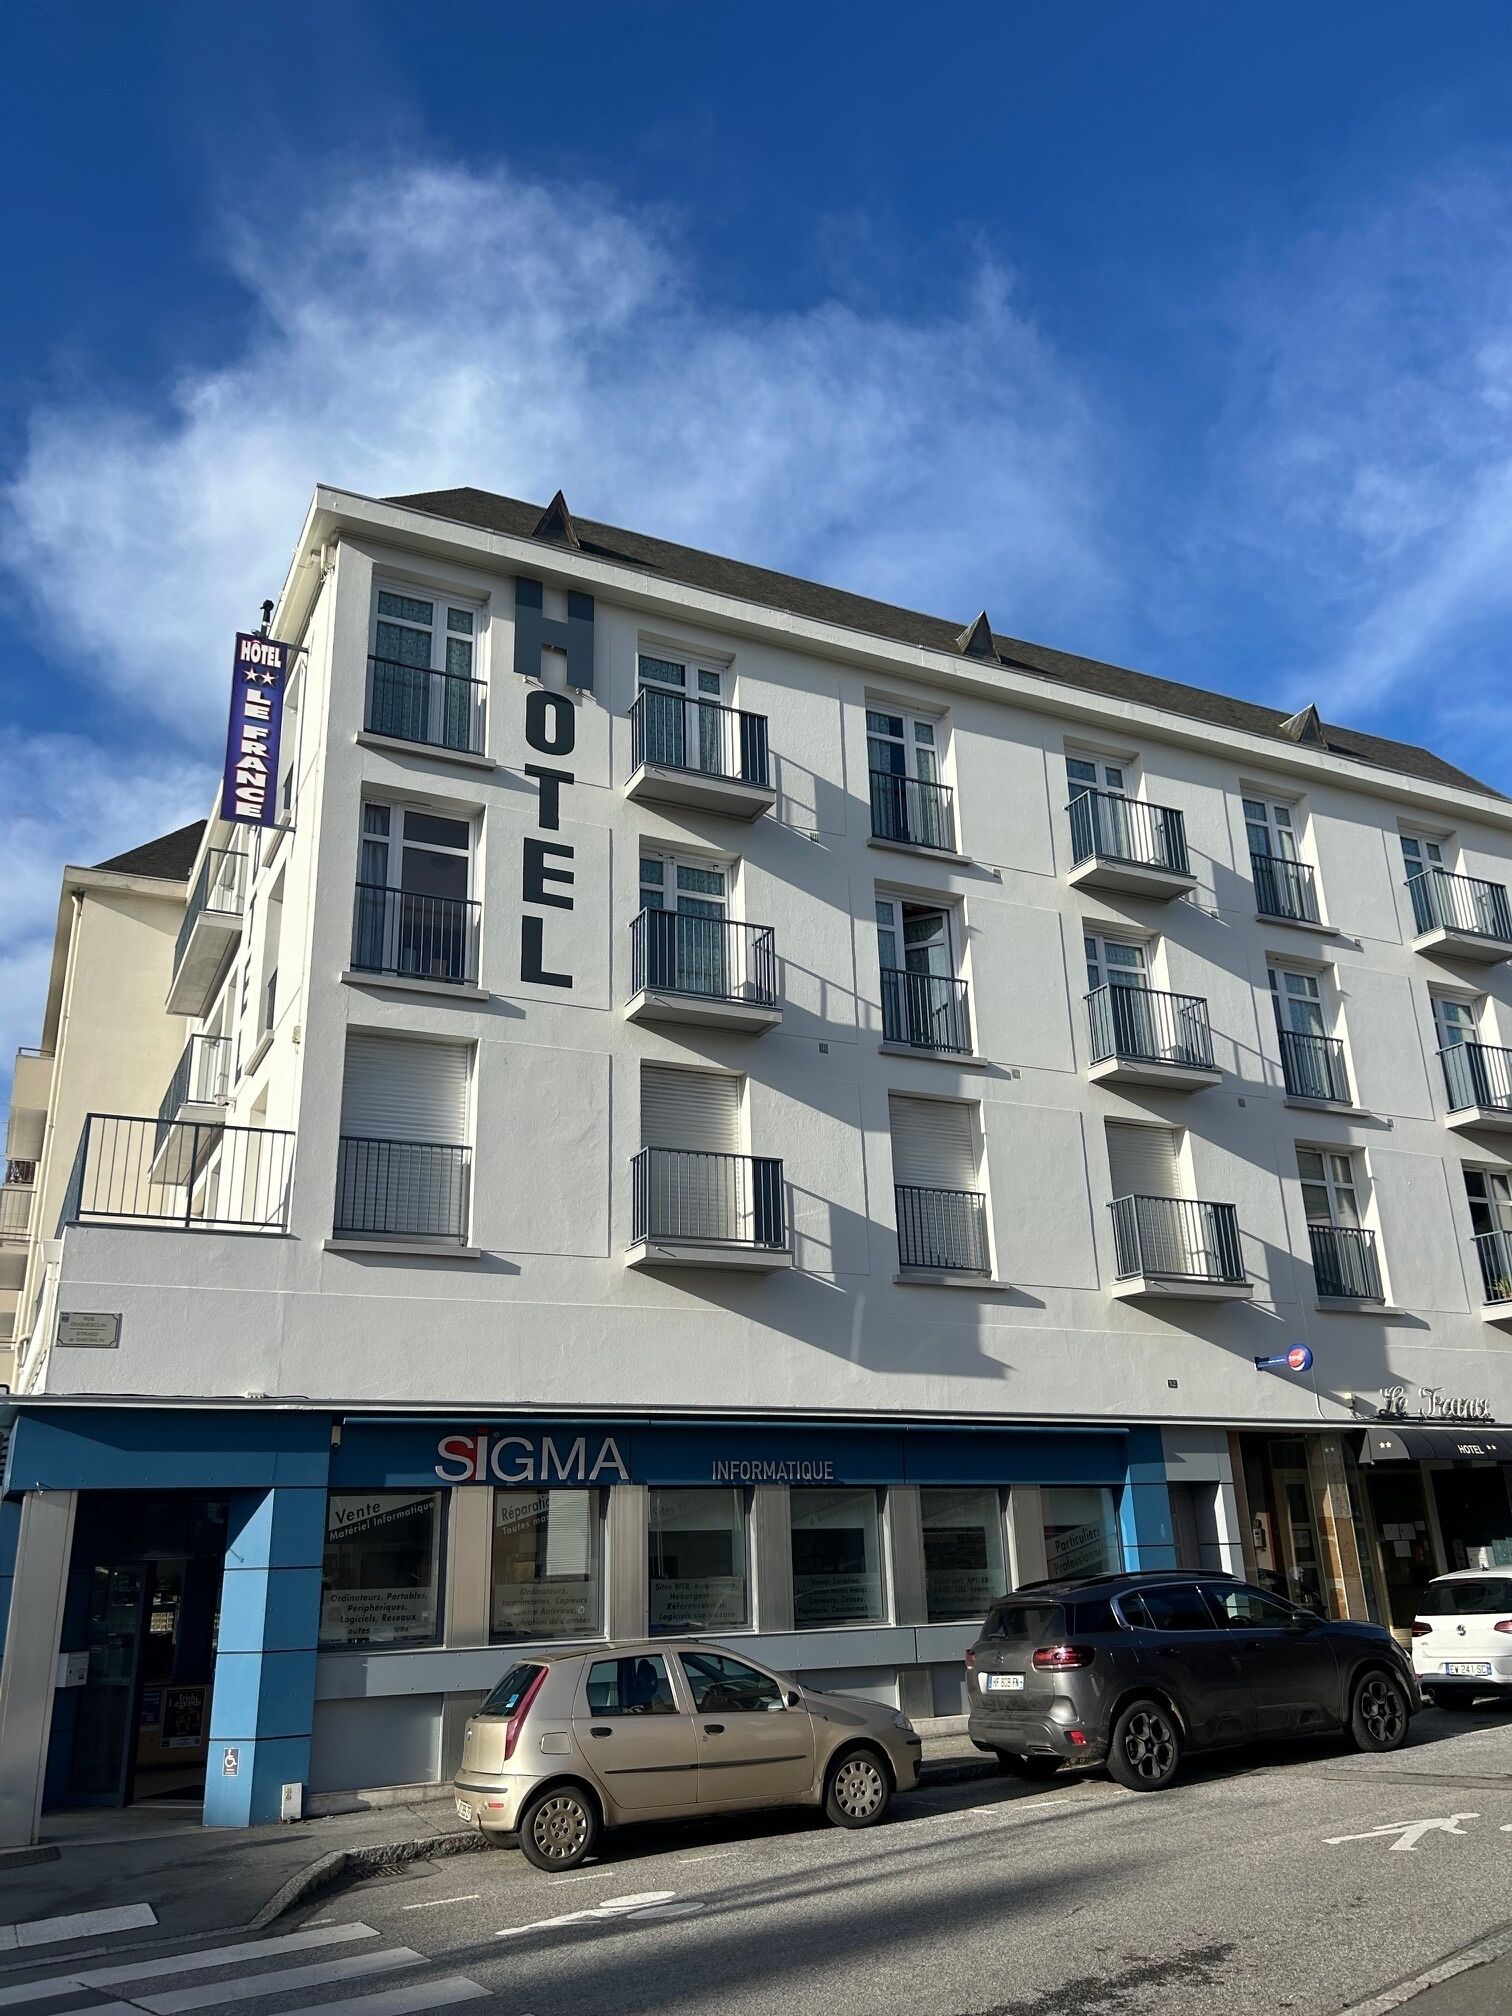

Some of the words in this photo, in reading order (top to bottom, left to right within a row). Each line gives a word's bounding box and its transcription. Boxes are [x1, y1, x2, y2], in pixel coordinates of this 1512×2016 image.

[240, 639, 282, 669] HÔTEL
[244, 688, 272, 721] LE
[235, 724, 271, 819] FRANCE
[514, 575, 595, 989] HOTEL
[1456, 1444, 1485, 1456] HOTEL
[711, 1460, 834, 1481] INFORMATIQUE
[329, 1518, 371, 1542] Matériel
[372, 1501, 435, 1527] Informatique
[334, 1502, 382, 1525] Vente
[501, 1495, 551, 1521] Réparatio
[330, 1592, 384, 1602] Ordinateurs,
